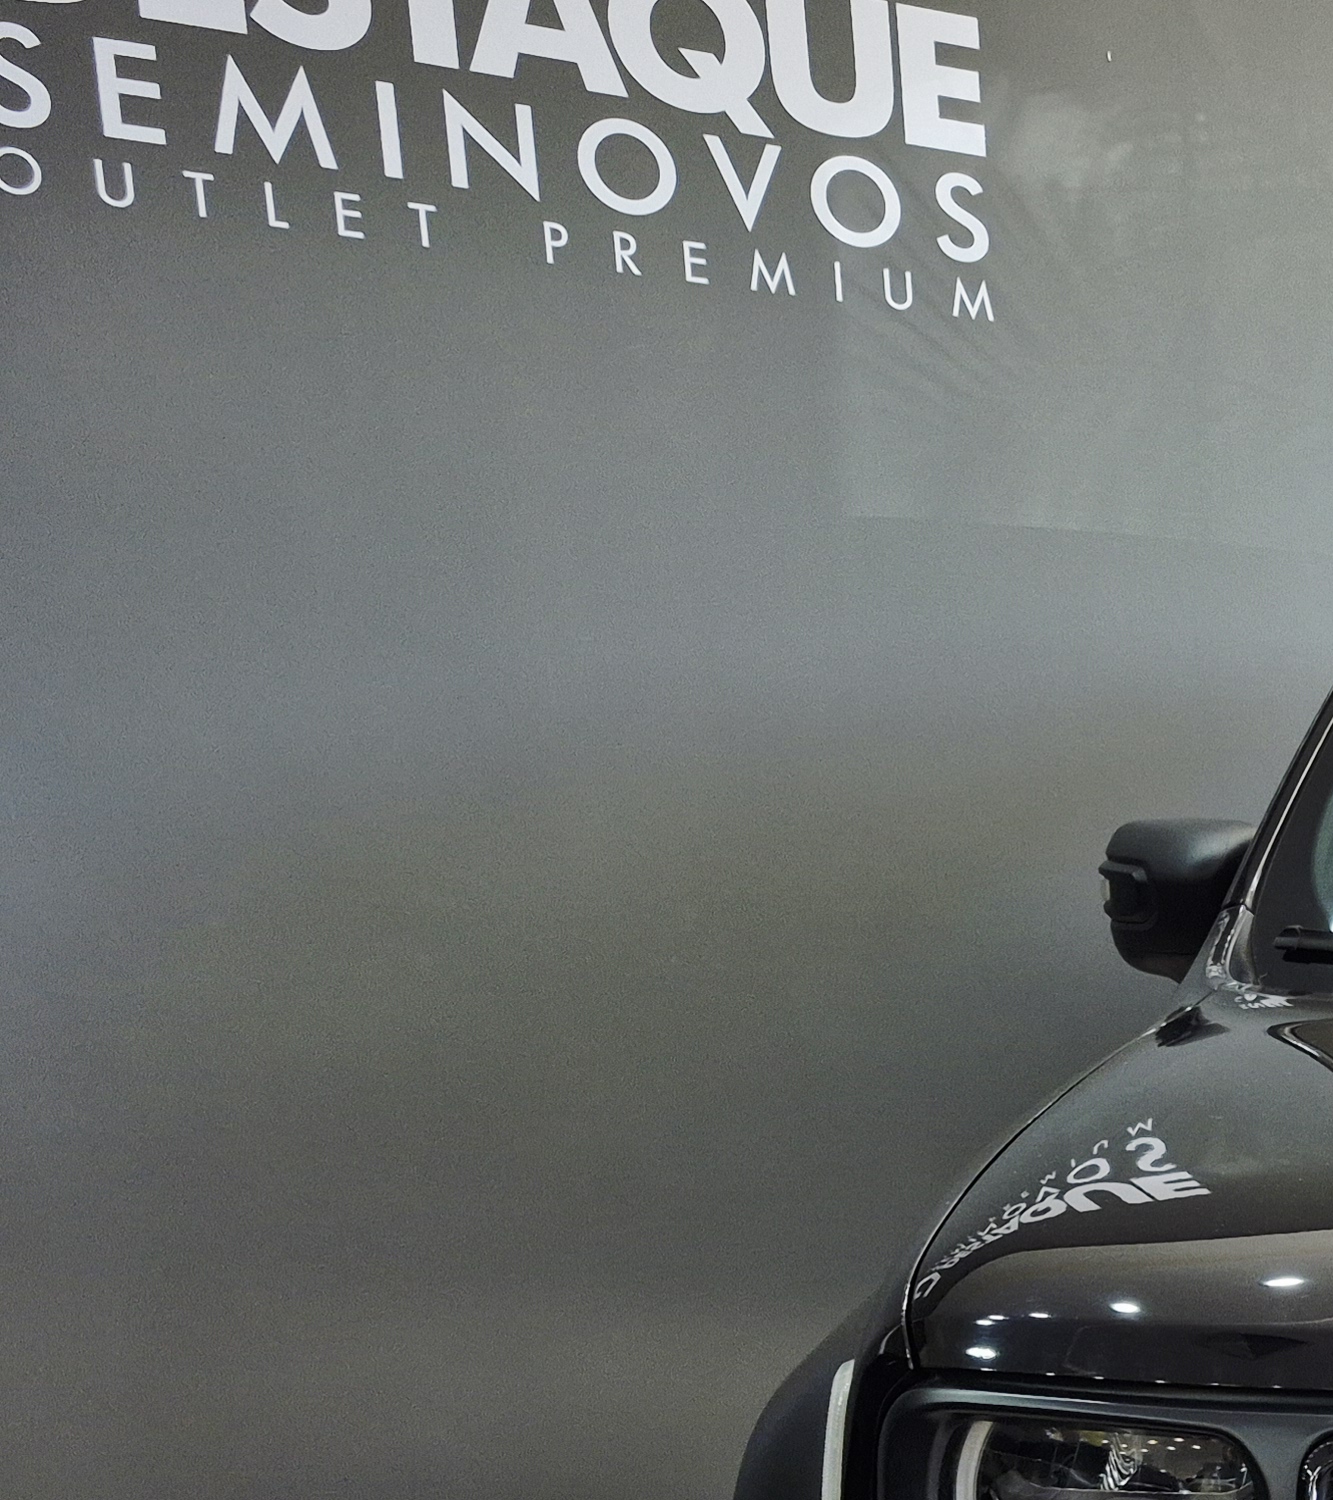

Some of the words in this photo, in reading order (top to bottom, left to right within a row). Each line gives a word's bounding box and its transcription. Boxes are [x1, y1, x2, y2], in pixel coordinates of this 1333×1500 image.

[0, 0, 987, 157] AQUE
[0, 21, 989, 262] SEMINOVOS
[0, 146, 437, 248] OUTLET
[543, 221, 994, 321] PREMIUM
